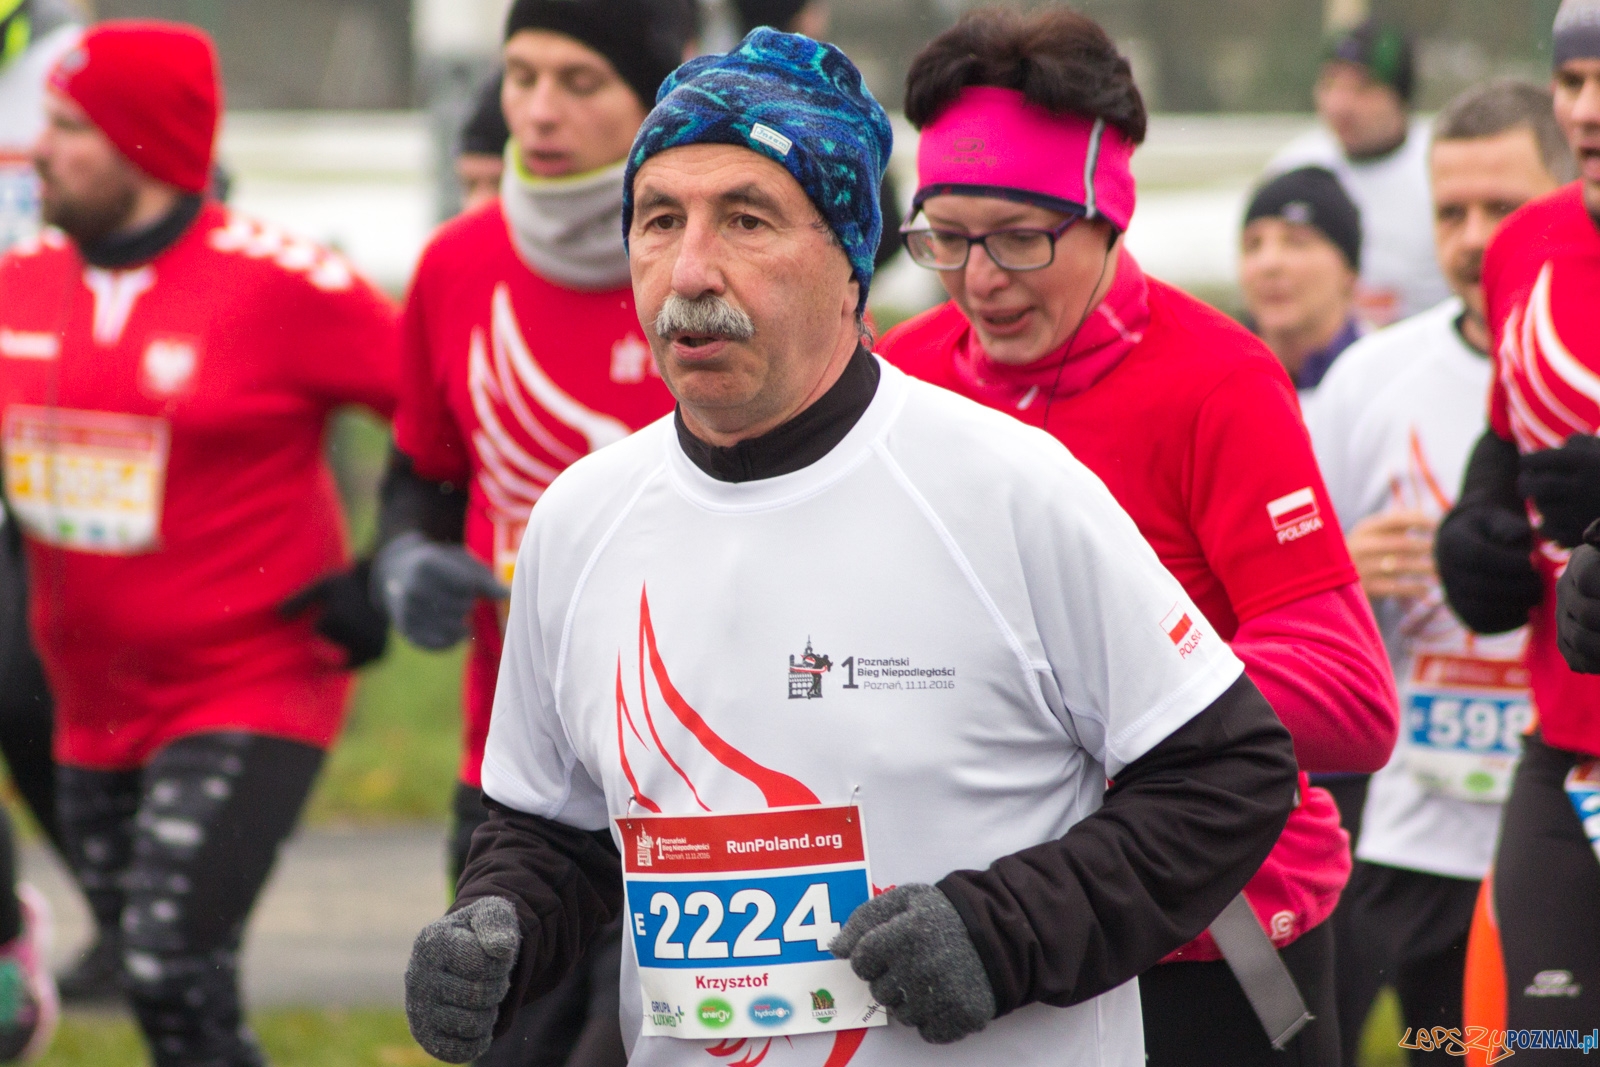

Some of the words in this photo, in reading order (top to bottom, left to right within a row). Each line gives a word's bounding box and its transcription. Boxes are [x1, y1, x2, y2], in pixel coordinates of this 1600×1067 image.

[1276, 518, 1324, 545] POLSKA
[857, 657, 910, 667] Poznański
[841, 656, 859, 689] 1
[857, 668, 880, 678] Bieg
[881, 667, 956, 678] Niepodległości
[905, 680, 956, 690] 11.11.2016
[726, 833, 843, 854] RunPoland.org
[633, 912, 647, 936] E
[649, 882, 842, 960] 2224
[695, 973, 770, 992] Krzysztof
[651, 1000, 671, 1013] GRUPA
[653, 1014, 678, 1028] LUXMED
[702, 1010, 731, 1022] energy
